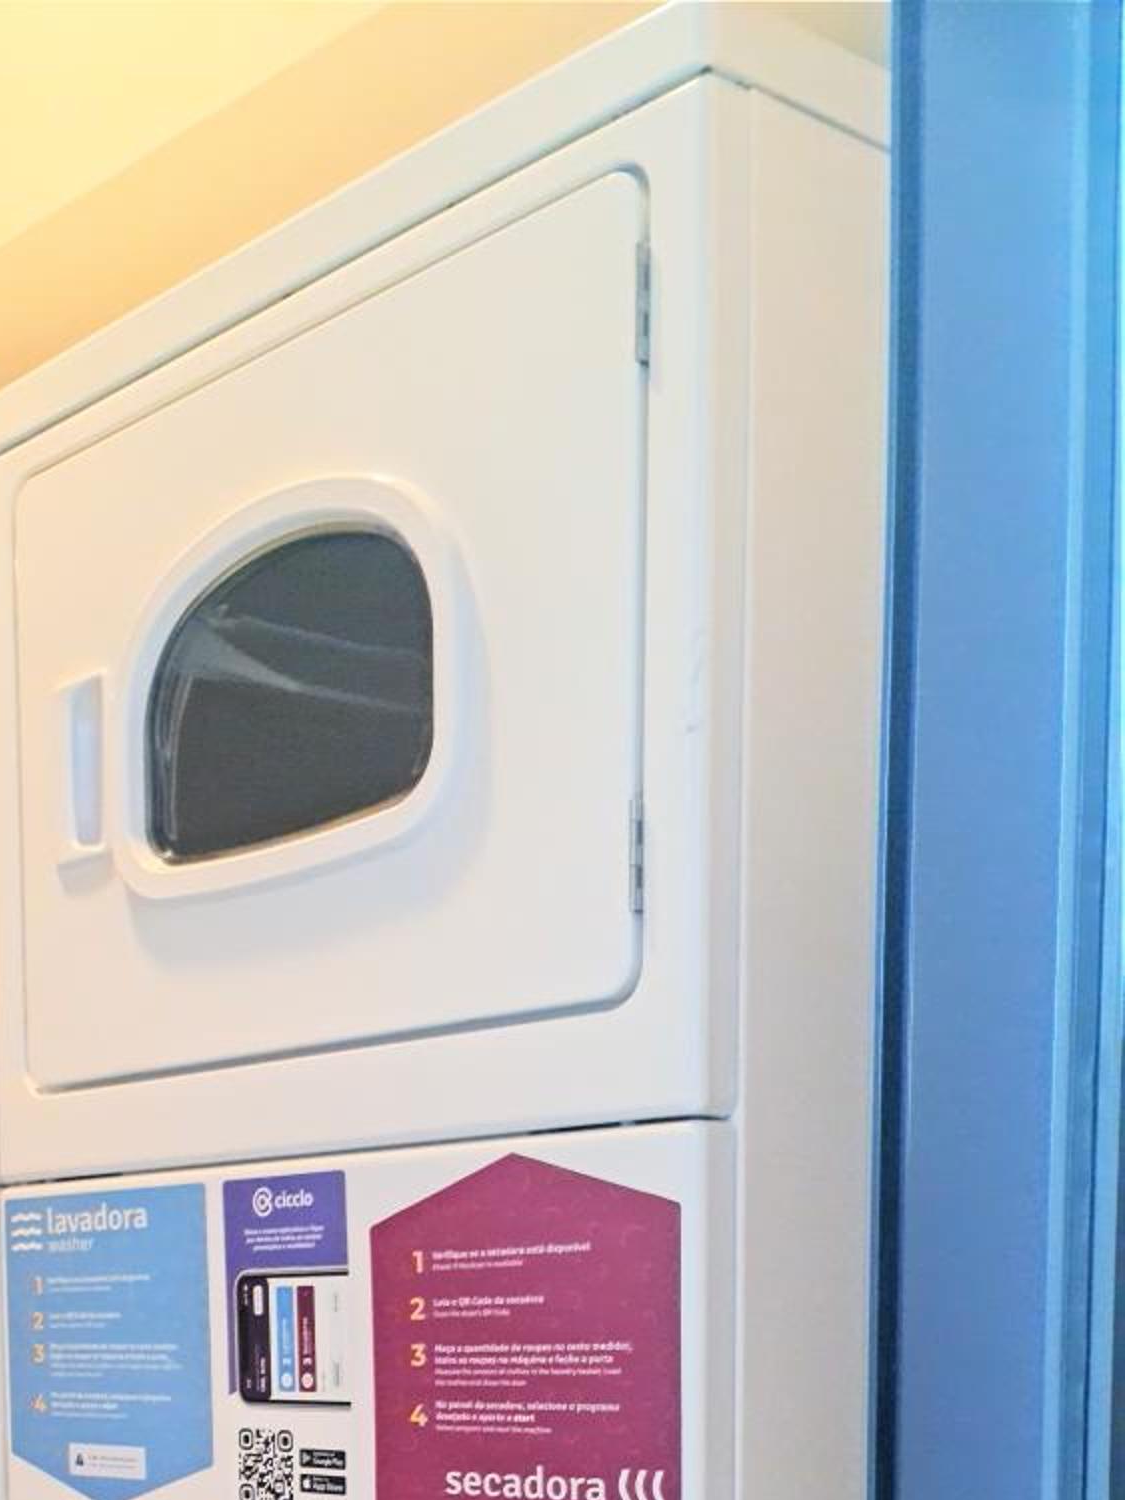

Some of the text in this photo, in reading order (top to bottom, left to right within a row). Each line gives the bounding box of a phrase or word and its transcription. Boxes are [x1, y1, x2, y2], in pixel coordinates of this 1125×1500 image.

[46, 1201, 149, 1236] lavadora
[46, 1238, 95, 1253] washer
[412, 1250, 424, 1273] 1
[410, 1297, 425, 1321] 2
[33, 1313, 44, 1331] 2
[33, 1344, 45, 1365] 3
[410, 1343, 426, 1367] 3
[410, 1403, 428, 1427] 4
[514, 1413, 535, 1423] start
